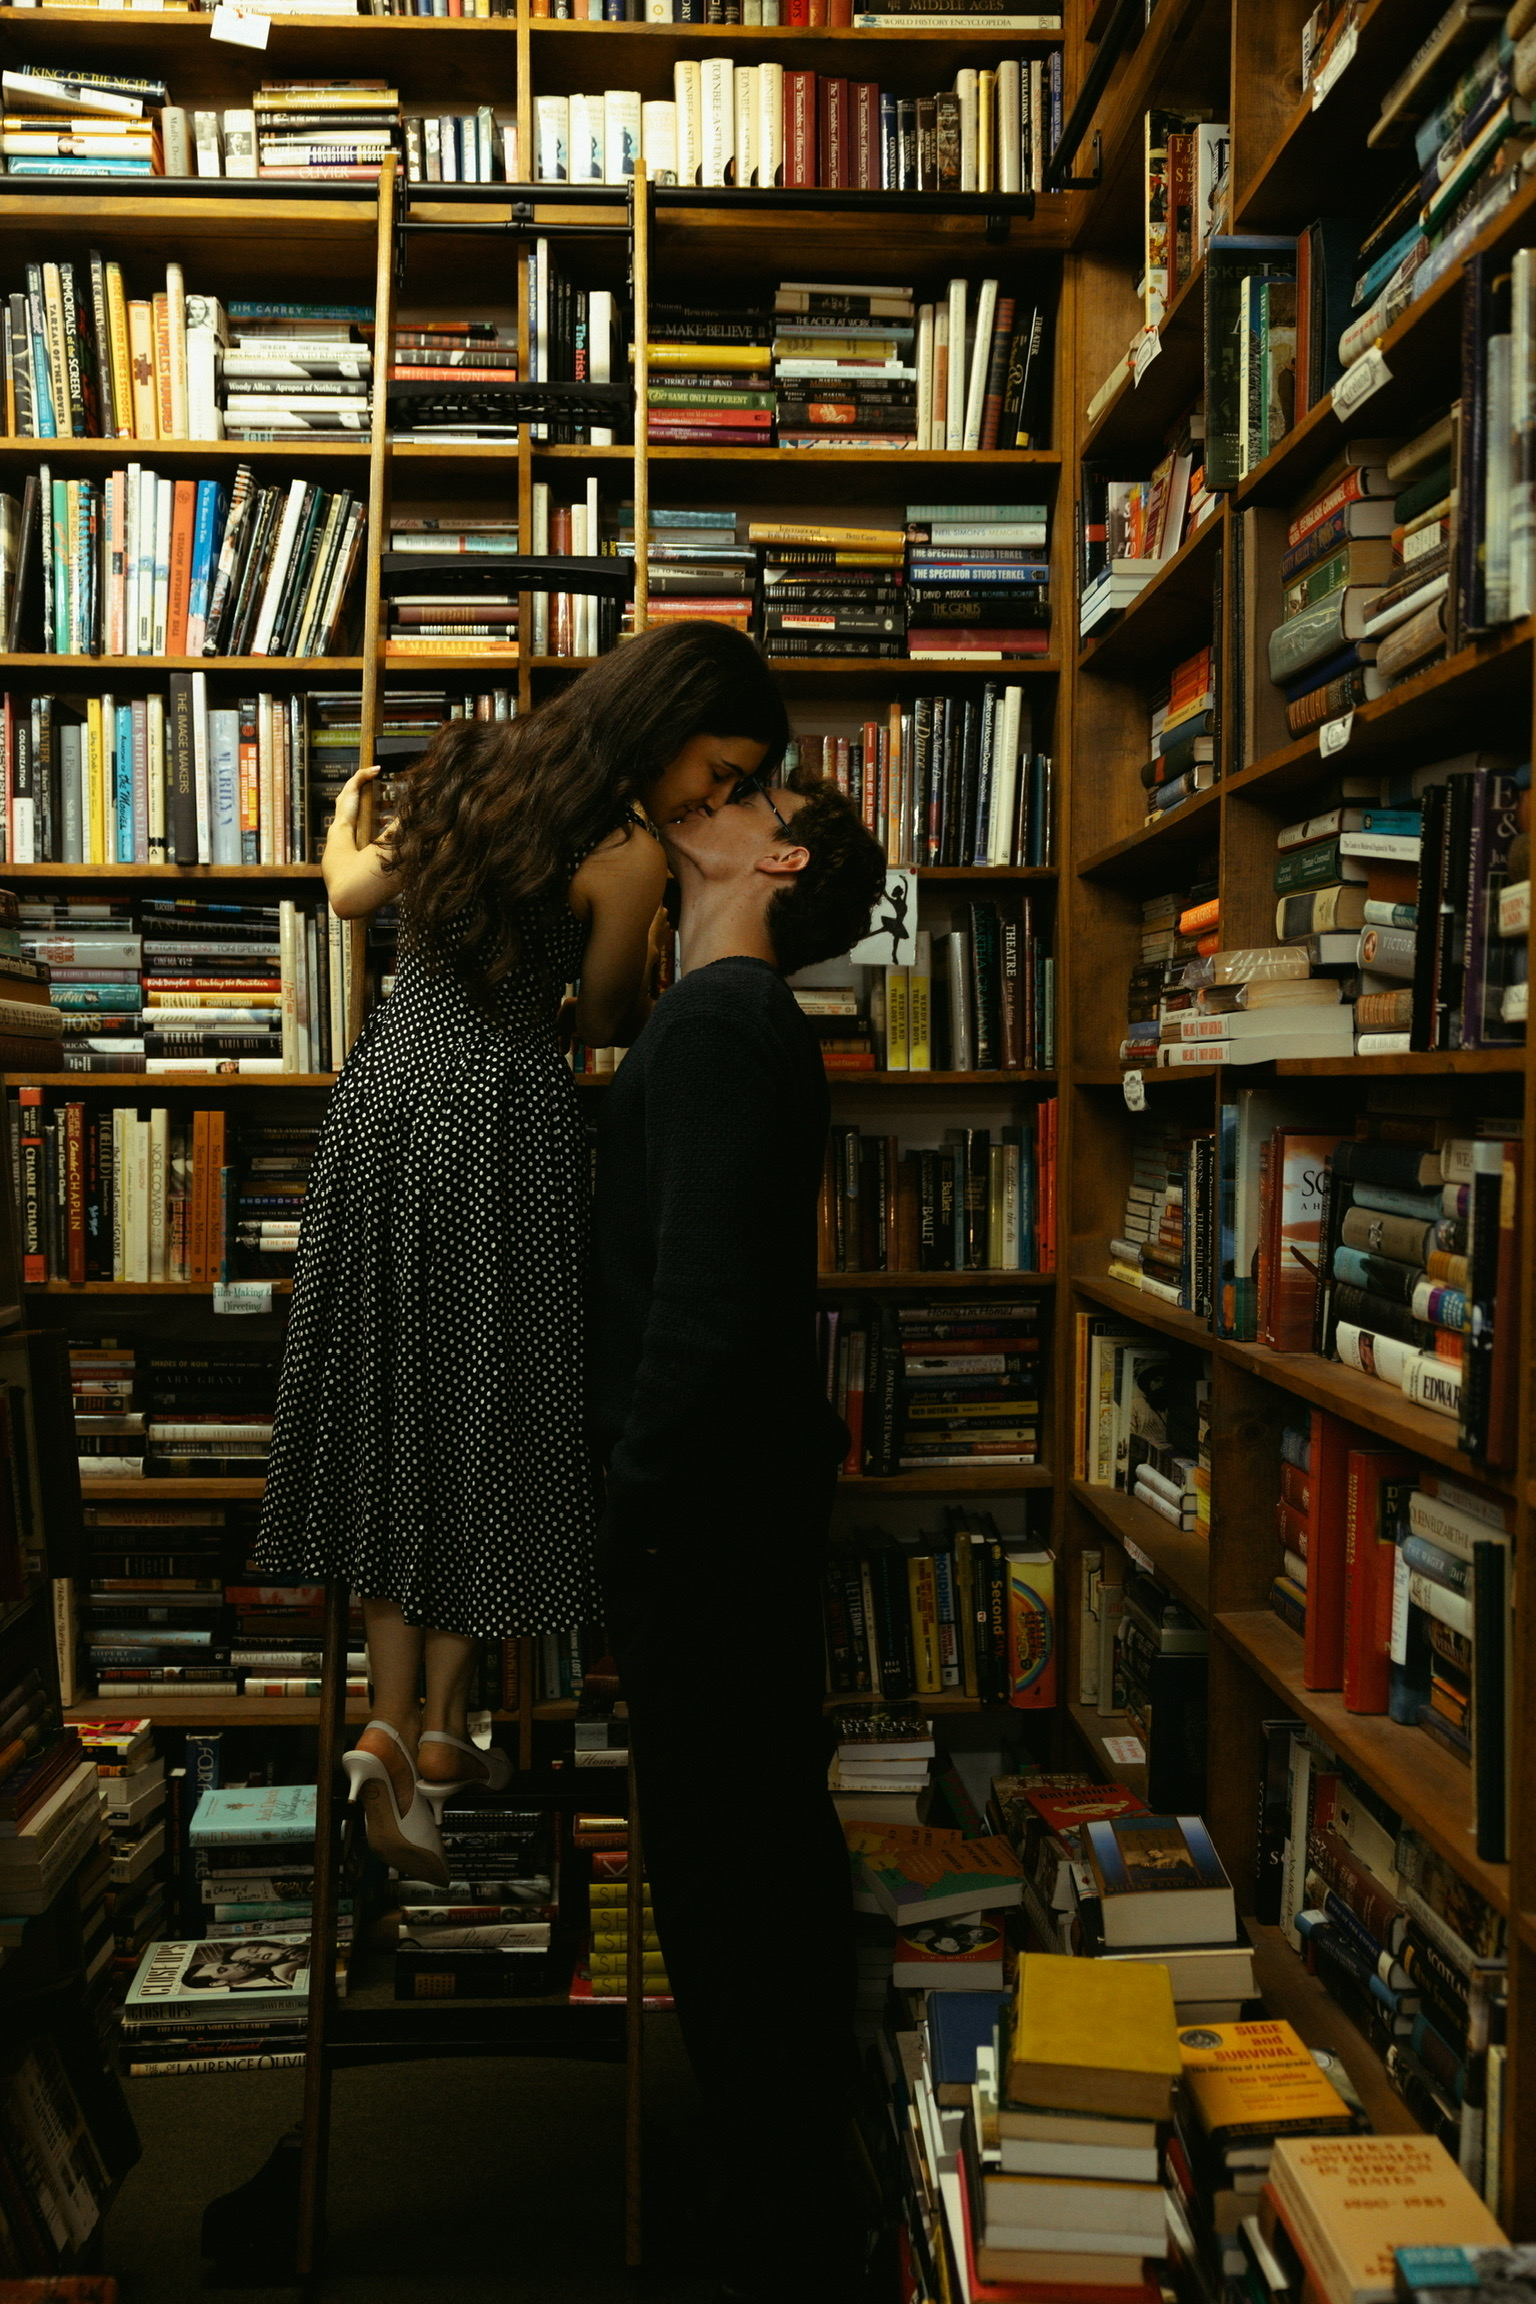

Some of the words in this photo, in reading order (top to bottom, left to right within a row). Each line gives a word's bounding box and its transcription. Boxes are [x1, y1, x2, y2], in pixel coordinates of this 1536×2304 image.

[883, 18, 912, 26] WORLD
[915, 18, 947, 26] HISTORY
[30, 67, 65, 81] KING
[796, 77, 804, 91] The
[830, 83, 838, 96] The
[860, 87, 868, 100] The
[796, 91, 804, 127] Timetables
[830, 97, 838, 133] Timetables
[860, 102, 868, 137] Timetables
[62, 273, 77, 335] IMMORTALS
[230, 304, 251, 313] JIM
[255, 305, 302, 315] CARREY
[575, 324, 586, 349] The
[54, 349, 60, 361] OF
[54, 364, 62, 383] THE
[68, 357, 81, 399] SCREEN
[228, 382, 251, 393] Woody
[275, 382, 304, 394] Apropos
[305, 383, 313, 392] of
[176, 532, 186, 566] MOVIES
[912, 548, 925, 558] THE
[926, 549, 969, 559] SPECTATOR
[970, 550, 995, 560] STUDS
[996, 550, 1024, 560] TERKEL
[913, 568, 927, 579] THE
[928, 569, 971, 580] SPECTATOR
[972, 570, 997, 580] STUDS
[997, 570, 1026, 581] TERKEL
[173, 569, 183, 615] AMERICAN
[172, 618, 180, 637] THE
[177, 691, 188, 712] THE
[178, 714, 189, 748] IMAGE
[66, 745, 75, 755] In
[916, 725, 931, 769] Dance
[18, 728, 26, 789] COLORIZATION
[65, 758, 75, 788] Pieces
[179, 750, 190, 794] MAKERS
[66, 820, 76, 842] Field
[1005, 924, 1016, 977] THEATRE
[890, 988, 898, 1005] THE
[890, 1006, 898, 1023] LOST
[897, 993, 905, 1021] WENDY
[912, 1006, 920, 1024] LOST
[897, 1022, 905, 1040] AND
[58, 1112, 66, 1125] The
[58, 1126, 66, 1145] Films
[25, 1147, 37, 1199] CHARLIE
[58, 1154, 66, 1178] Charlie
[70, 1173, 81, 1230] CHAPLIN
[941, 1181, 953, 1212] Ballet
[26, 1201, 39, 1254] CHAPLIN
[922, 1205, 935, 1247] BALLET
[223, 1301, 262, 1313] Directing
[885, 1369, 895, 1410] PATRICK
[882, 1414, 893, 1460] STEWART
[991, 1580, 1004, 1635] Second
[411, 1888, 432, 1897] Keith
[433, 1888, 470, 1897] Richards
[154, 1944, 189, 1964] UPS
[140, 1964, 180, 1996] CLOSE
[131, 2003, 167, 2020] CLOSE
[168, 2002, 192, 2018] UPS
[1234, 2023, 1283, 2036] SIEGE
[1251, 2034, 1283, 2046] and
[1213, 2046, 1299, 2062] SURVIVAL
[175, 2058, 255, 2075] LAURENCE
